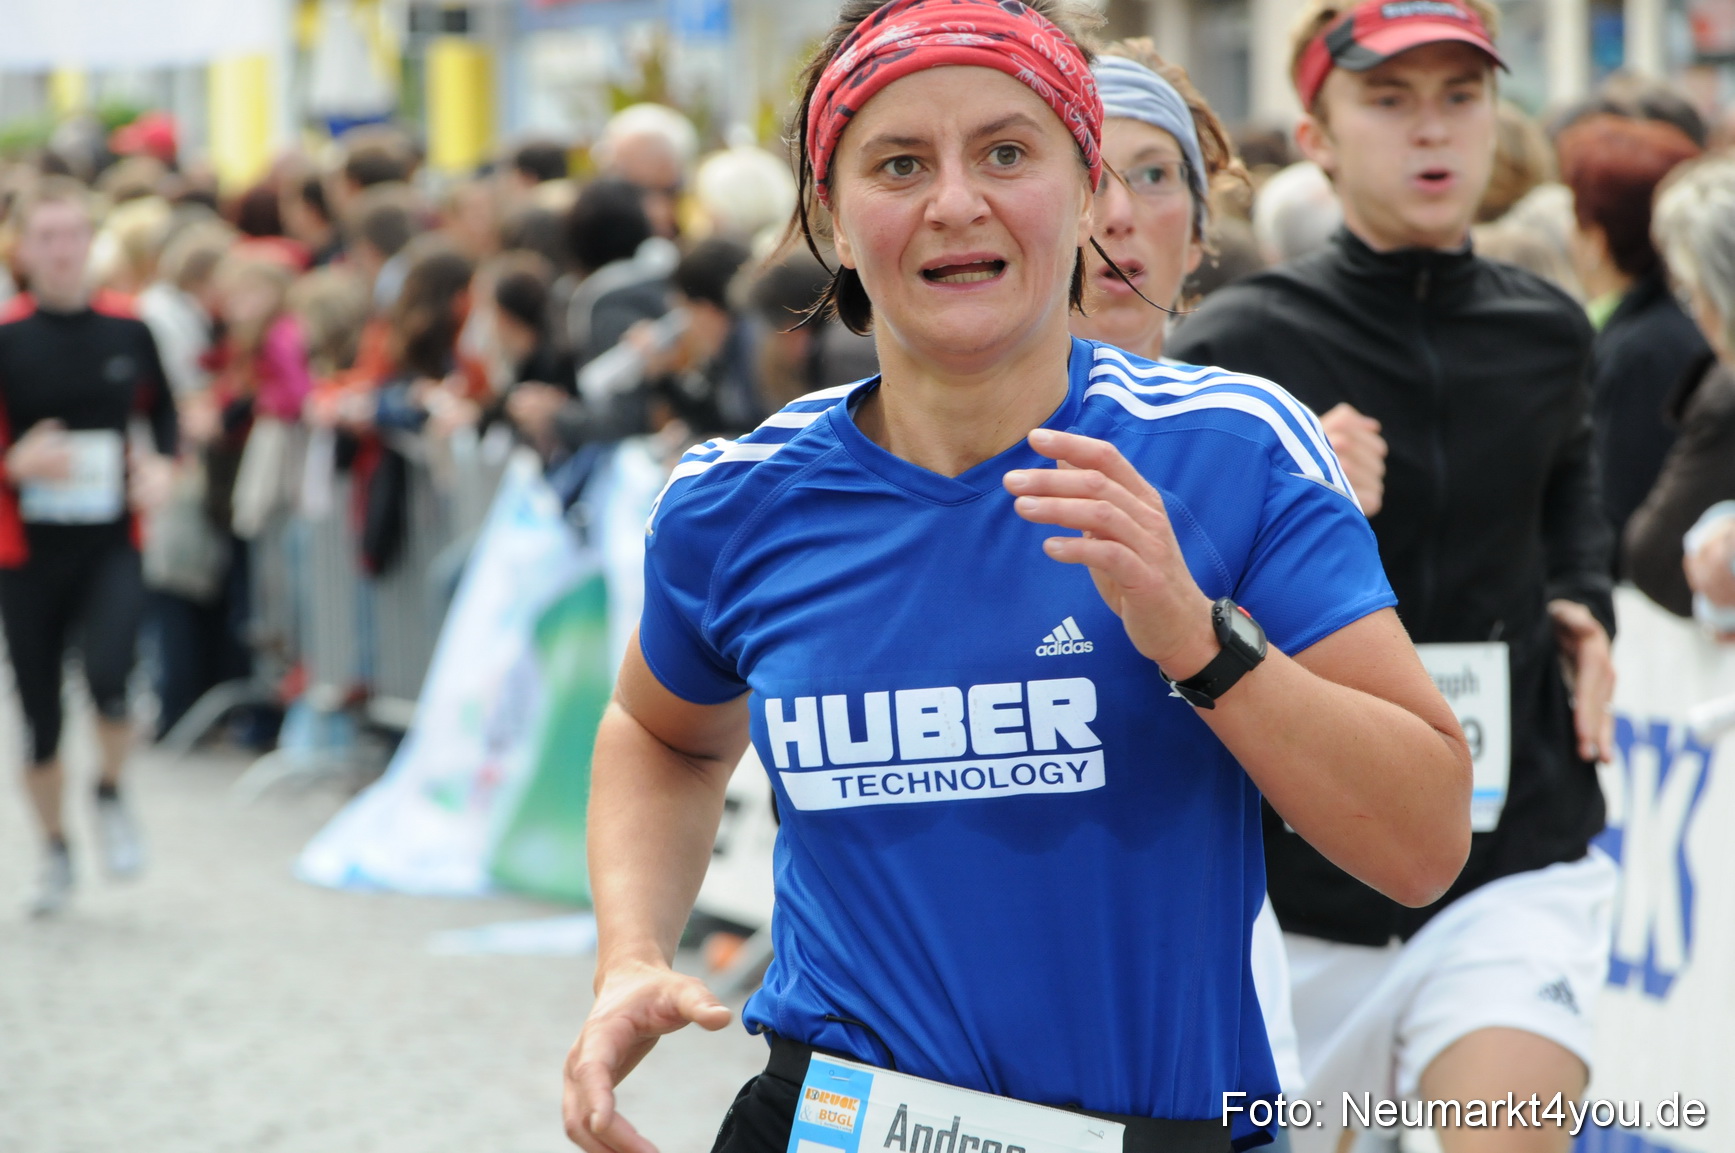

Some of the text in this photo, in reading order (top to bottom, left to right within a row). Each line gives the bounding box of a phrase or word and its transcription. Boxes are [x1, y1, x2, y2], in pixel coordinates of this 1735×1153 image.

[1035, 639, 1094, 657] adidas
[764, 677, 1103, 769] HUBER
[832, 760, 1090, 799] TECHNOLOGY
